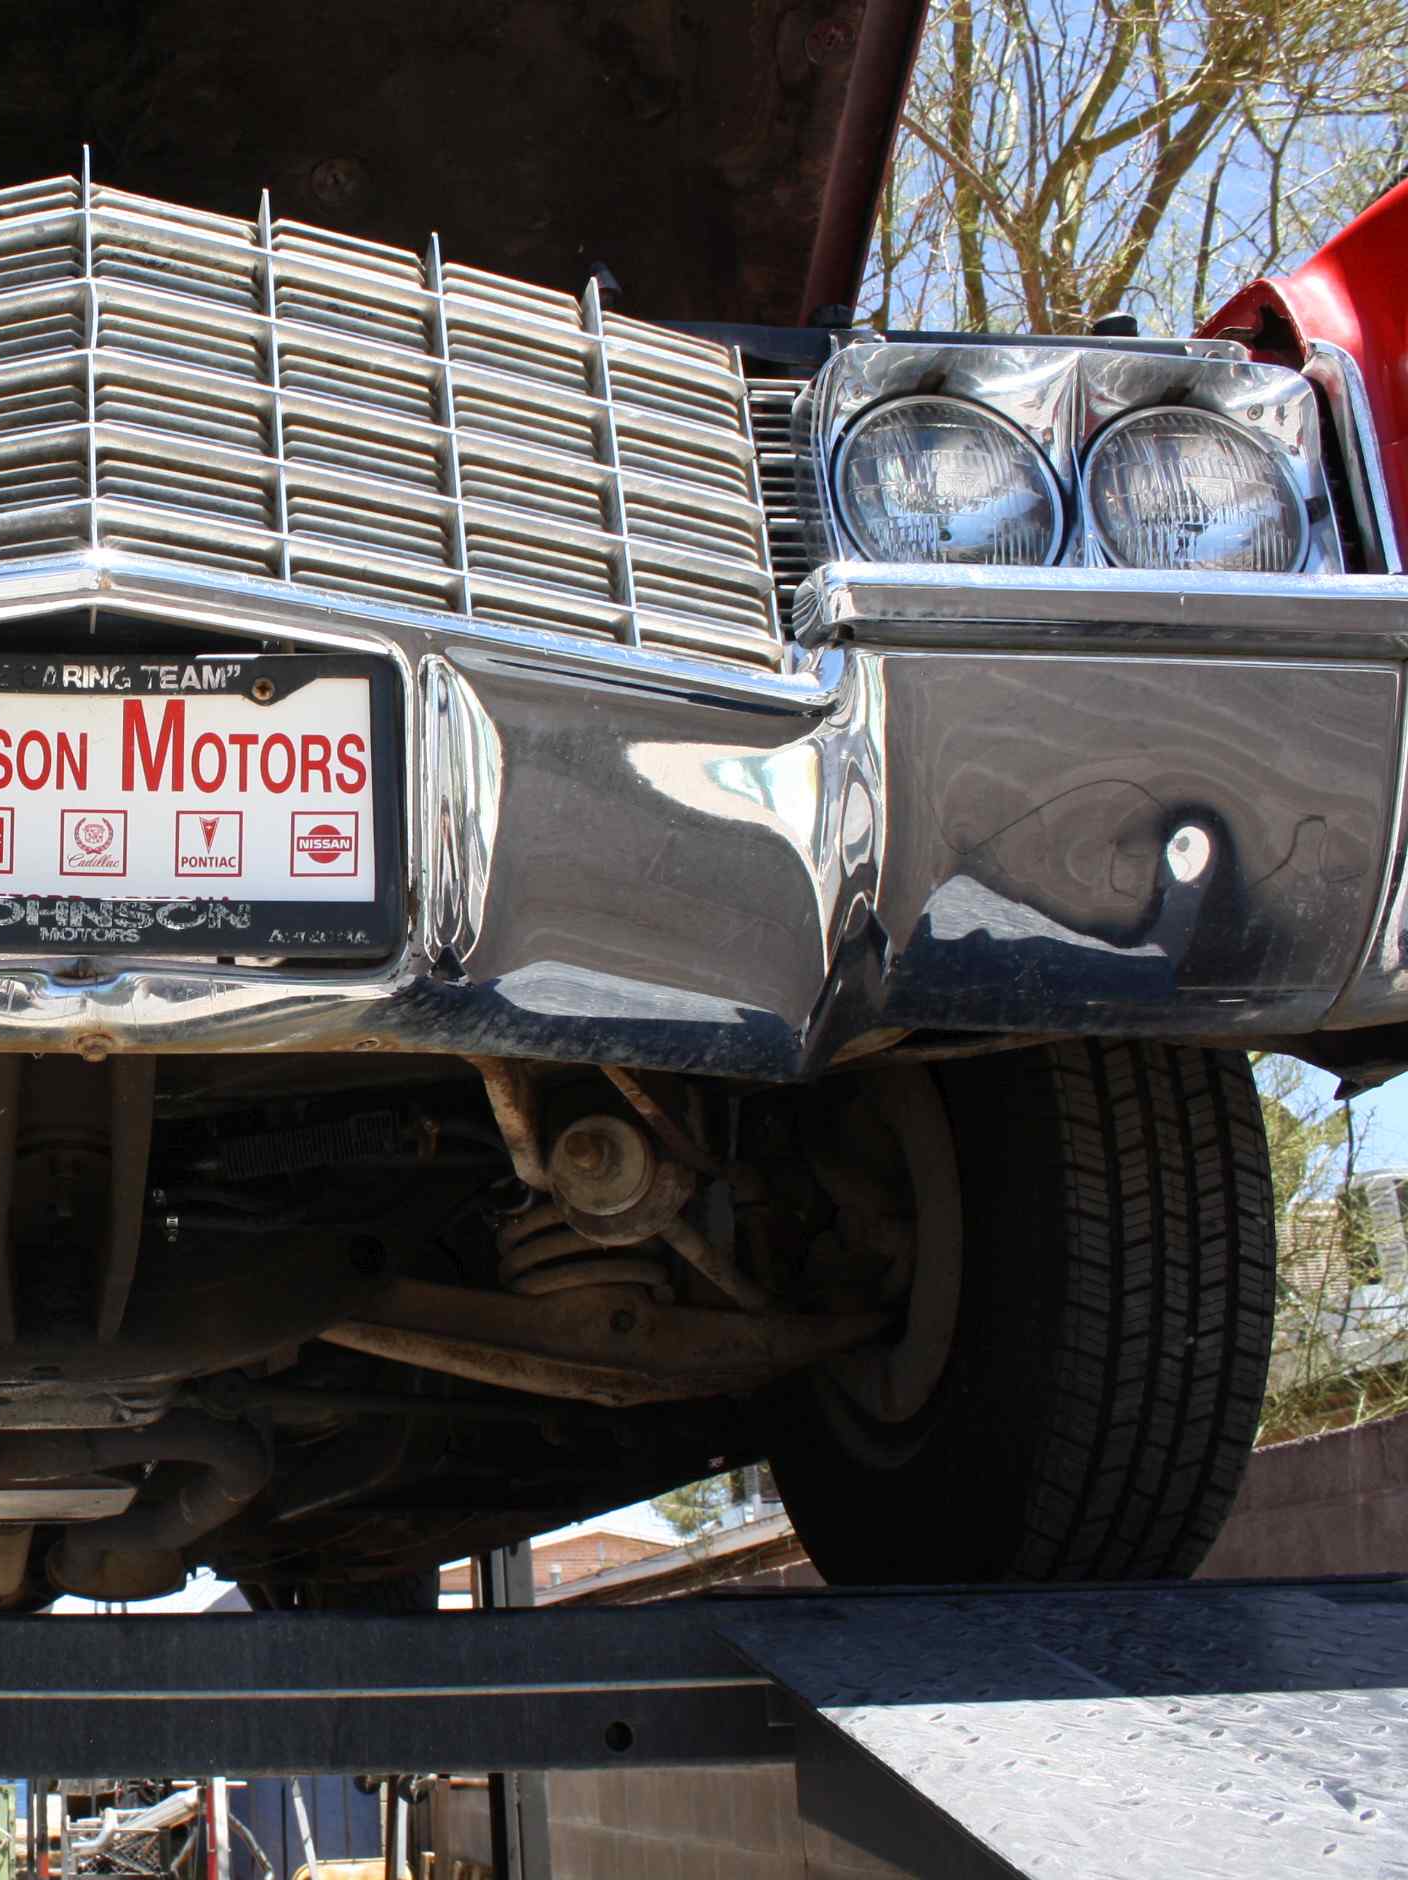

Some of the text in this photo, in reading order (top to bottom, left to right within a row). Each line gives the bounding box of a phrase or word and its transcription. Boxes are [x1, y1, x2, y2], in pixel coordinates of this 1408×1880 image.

[24, 664, 132, 689] ARING
[140, 664, 242, 690] TEAM”
[121, 699, 367, 794] MOTORS
[299, 839, 350, 849] NISSAN
[66, 853, 120, 869] Cadillac
[181, 856, 236, 868] PONTIAC
[40, 926, 141, 944] MOTORS
